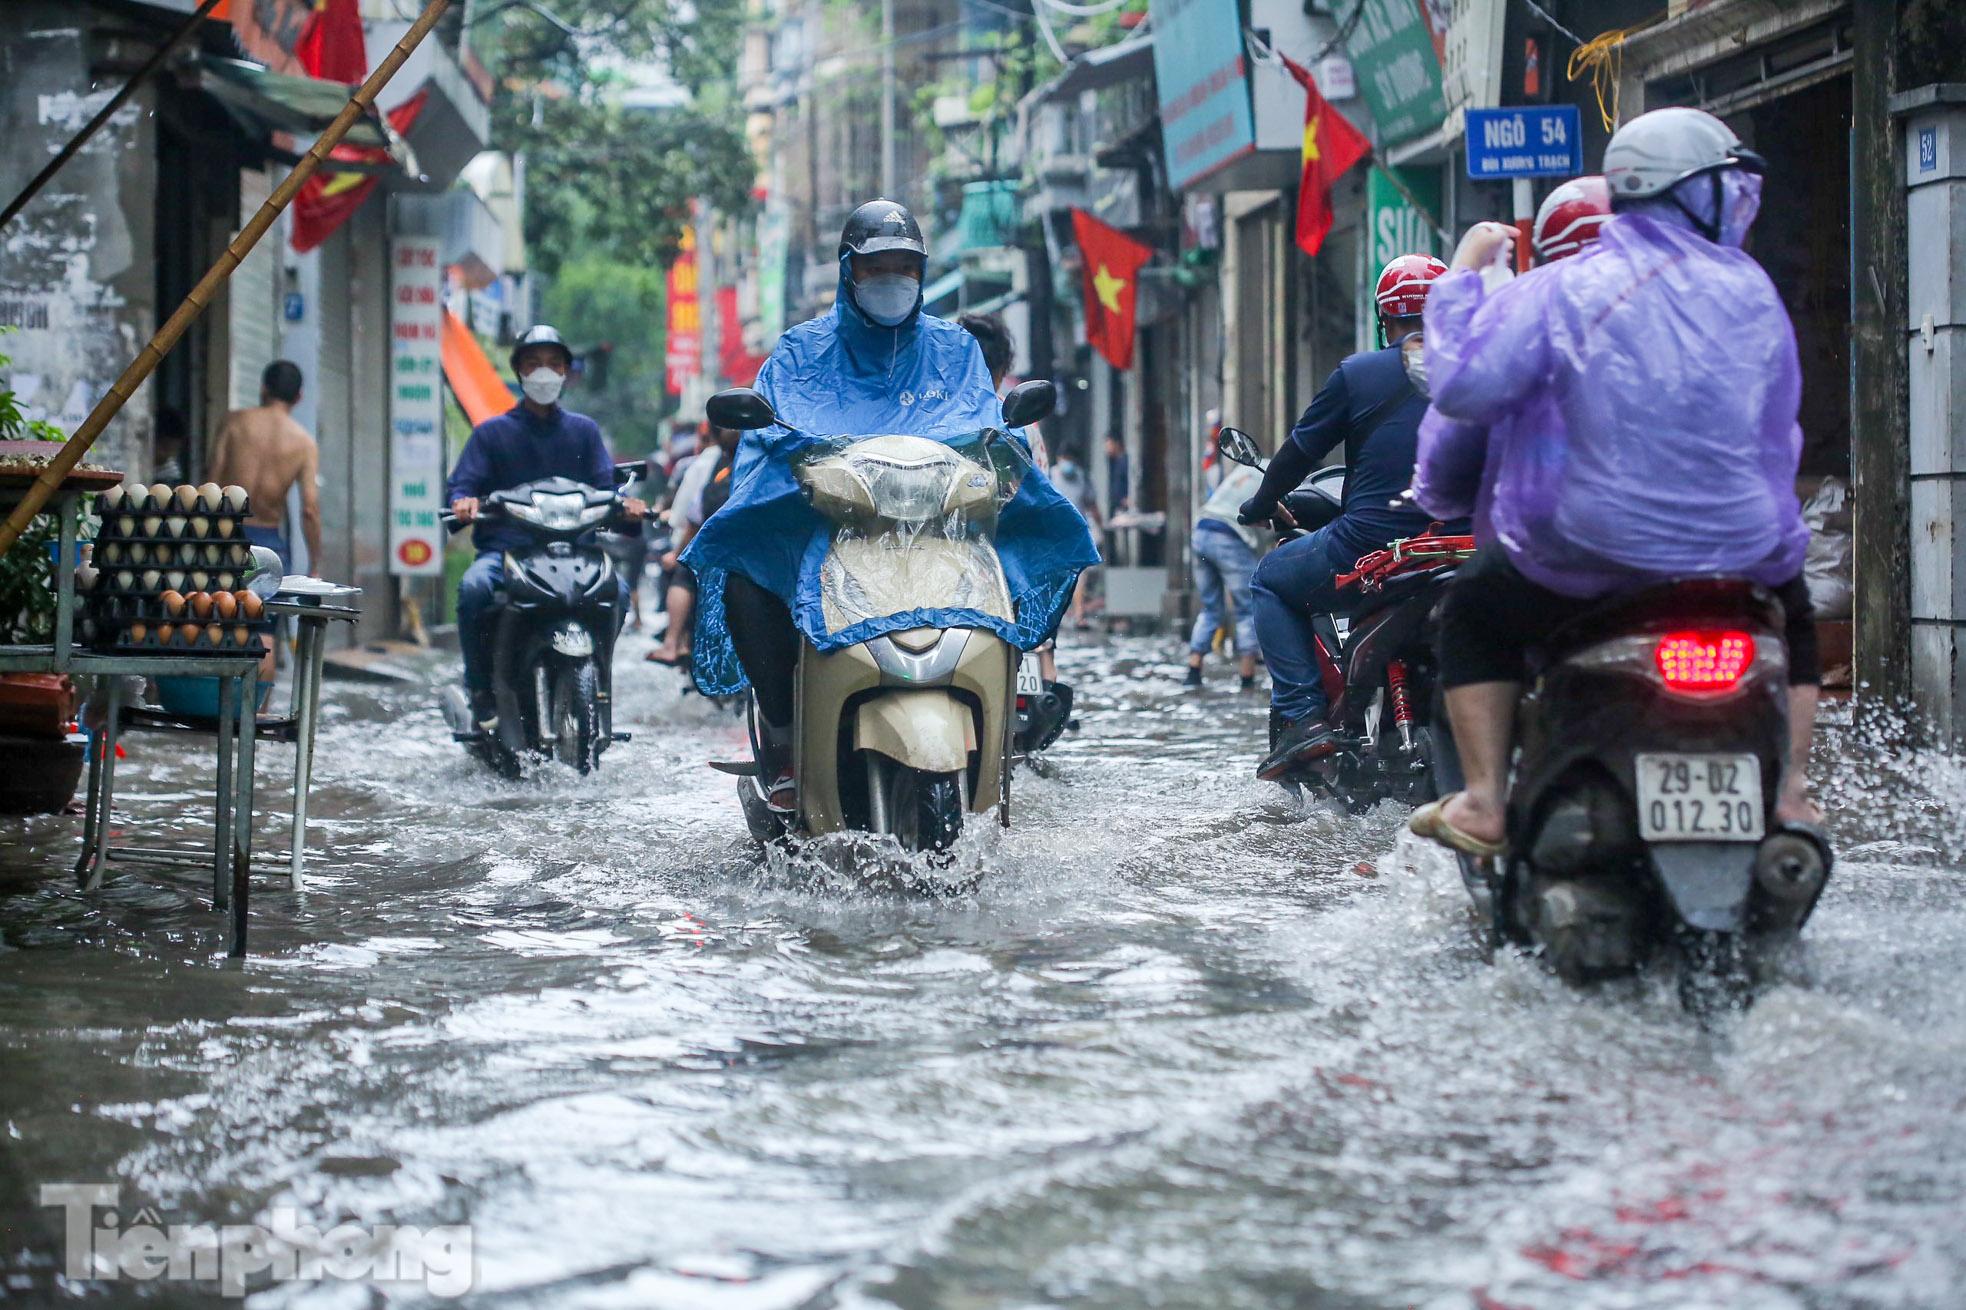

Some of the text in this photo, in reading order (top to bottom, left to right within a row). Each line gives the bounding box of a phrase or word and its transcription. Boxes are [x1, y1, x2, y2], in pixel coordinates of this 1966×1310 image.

[1484, 113, 1566, 149] NGÕ 54
[1922, 134, 1932, 163] 52
[1650, 800, 1753, 833] 012.30
